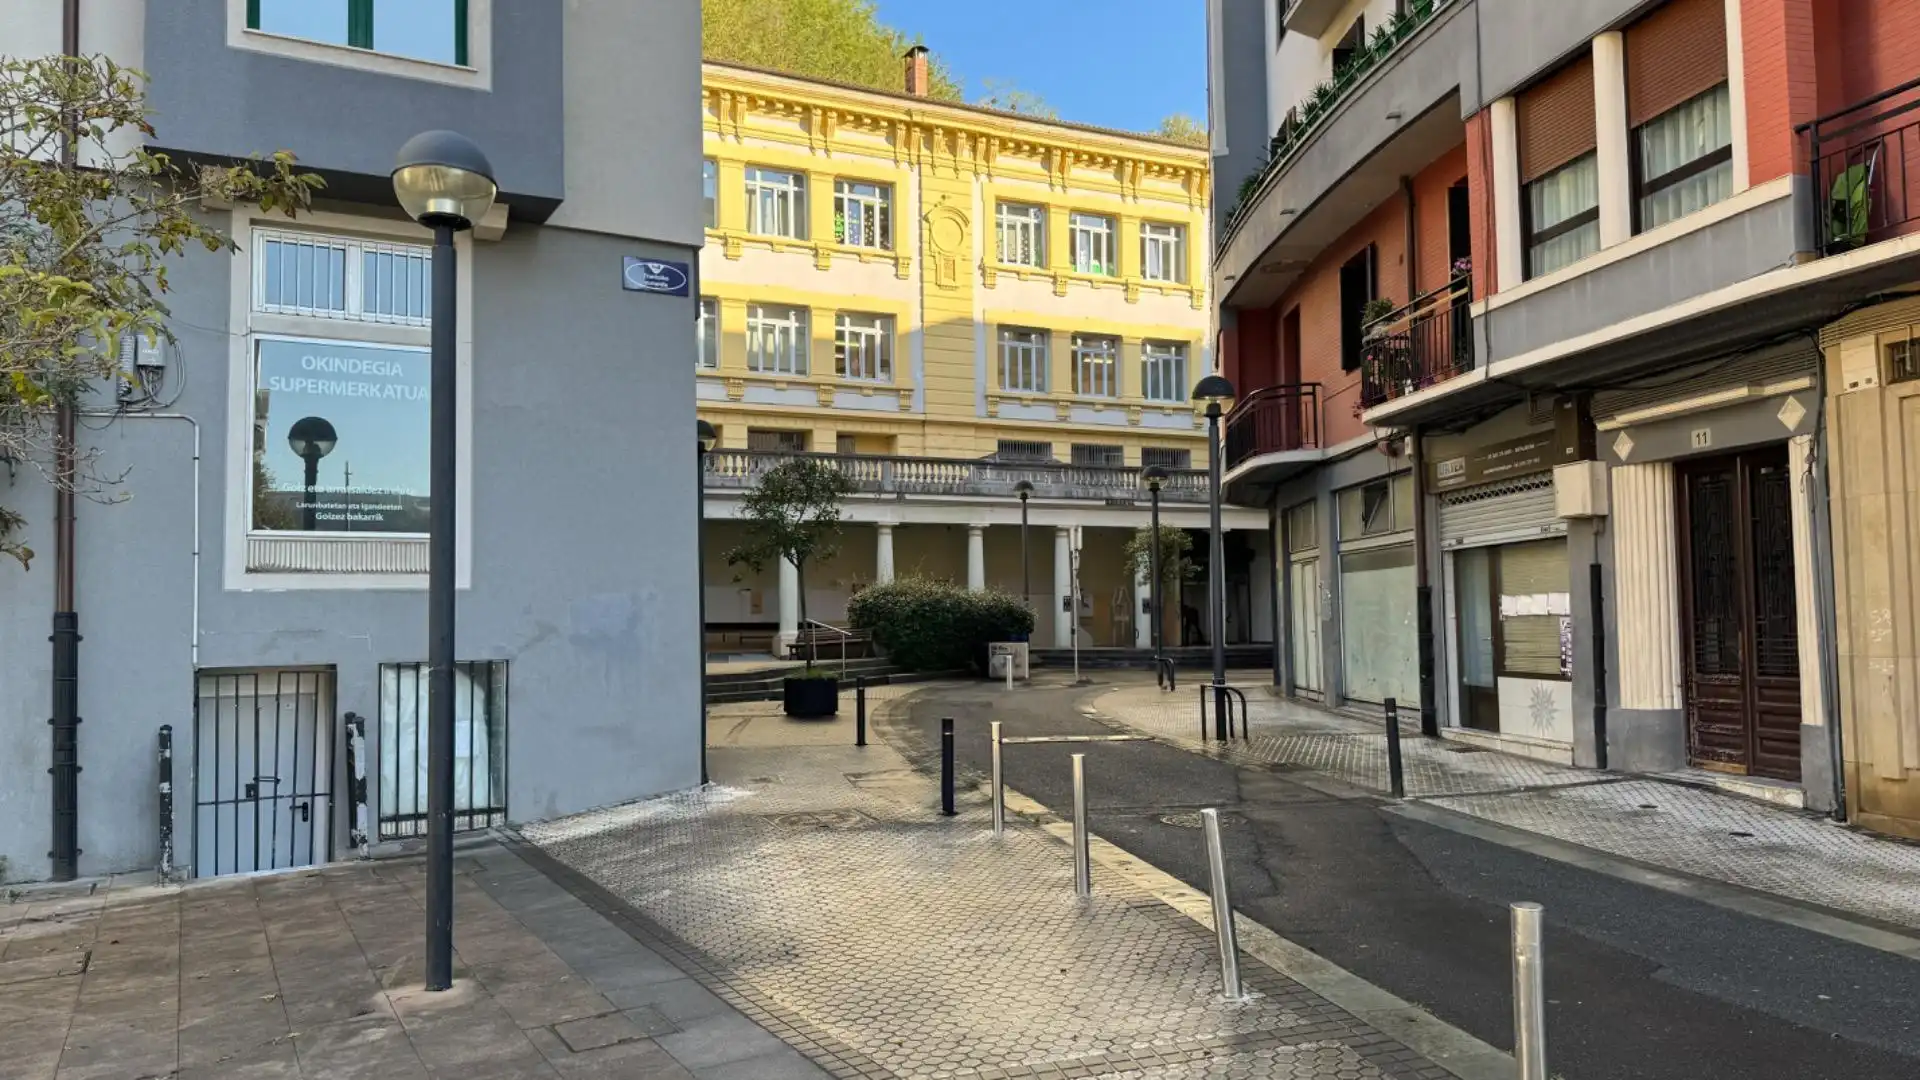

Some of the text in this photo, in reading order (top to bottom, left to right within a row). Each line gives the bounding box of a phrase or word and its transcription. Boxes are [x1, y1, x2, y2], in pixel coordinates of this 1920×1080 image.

[301, 355, 403, 377] OKINDEGIA
[269, 375, 429, 401] SUPERMERKATUA
[1696, 431, 1707, 446] 11
[315, 511, 384, 521] Goizez bakarrik
